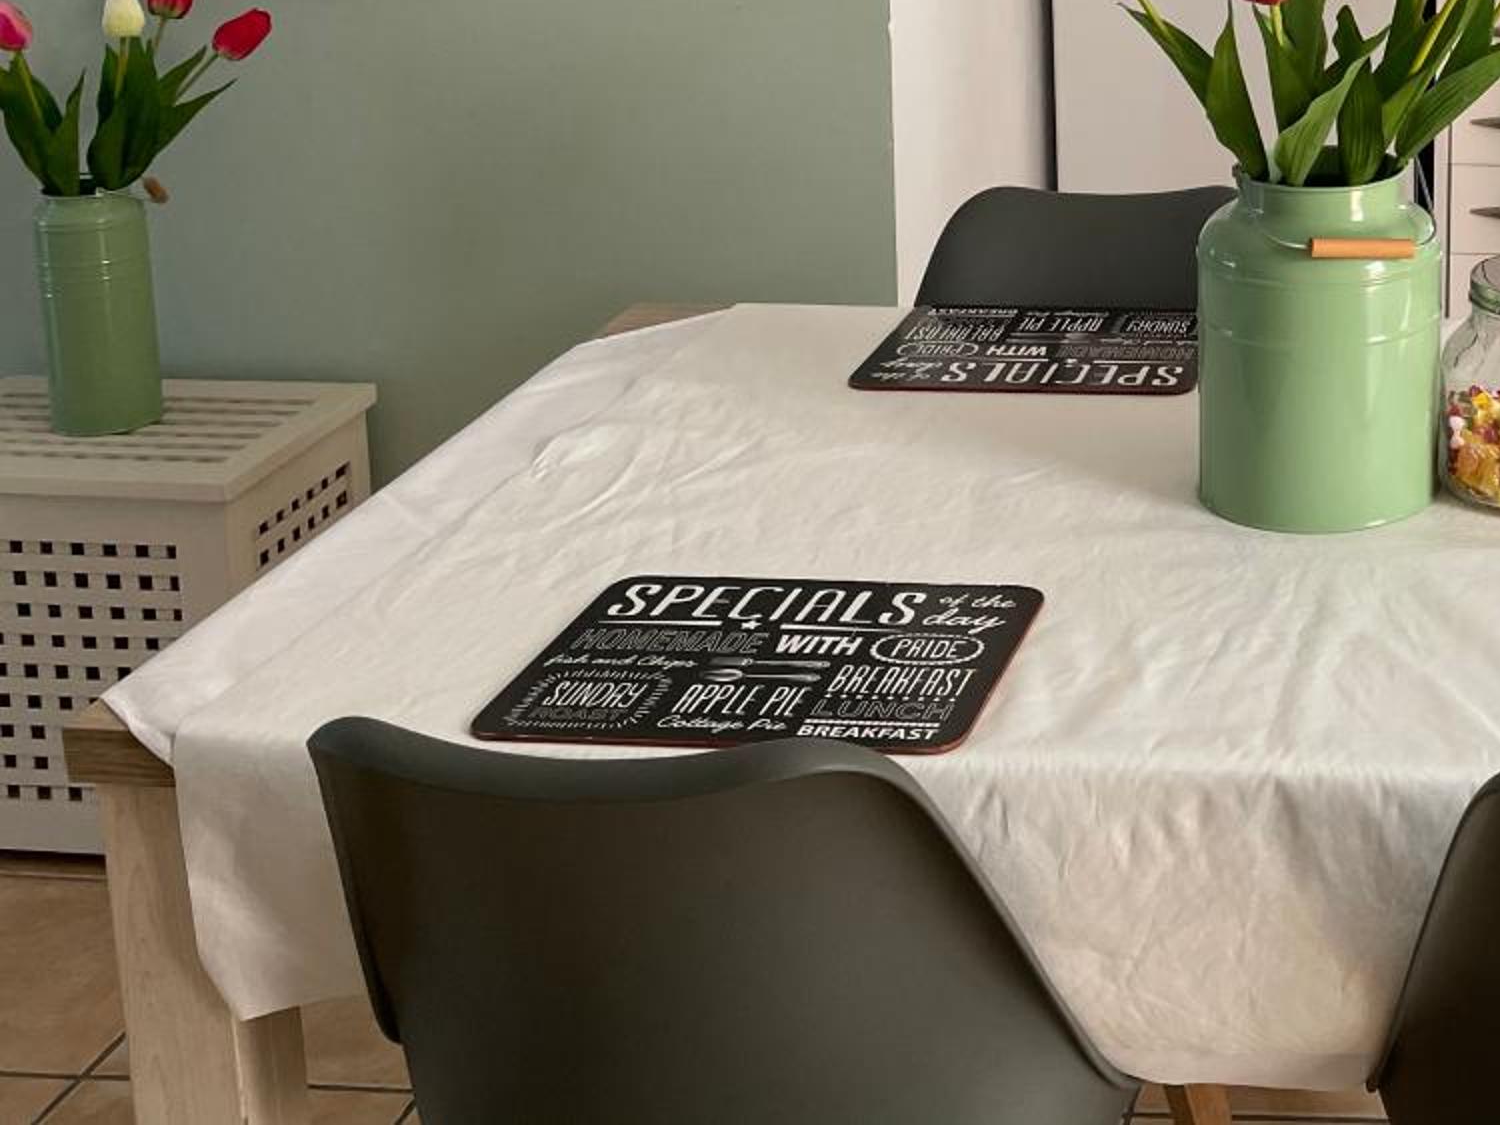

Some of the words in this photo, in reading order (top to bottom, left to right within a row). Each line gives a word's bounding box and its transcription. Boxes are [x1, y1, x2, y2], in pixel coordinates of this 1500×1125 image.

[986, 345, 1047, 356] WITH
[941, 362, 1184, 386] SPECIALS
[607, 584, 927, 625] SPECIALS
[939, 592, 968, 607] of
[971, 593, 1016, 609] the
[922, 607, 1007, 635] day
[572, 628, 770, 653] HOMEMADE
[775, 634, 863, 655] WITH
[890, 638, 967, 659] PRIDE
[592, 655, 638, 665] and
[828, 664, 977, 696] BREAKFAST
[541, 680, 649, 708] SUNDAY
[671, 683, 765, 714] APPLE
[759, 686, 813, 717] PIE
[810, 698, 956, 721] LUNCH
[657, 714, 745, 734] Cottage
[746, 717, 789, 731] Pie
[796, 725, 939, 740] BREAKFAST
